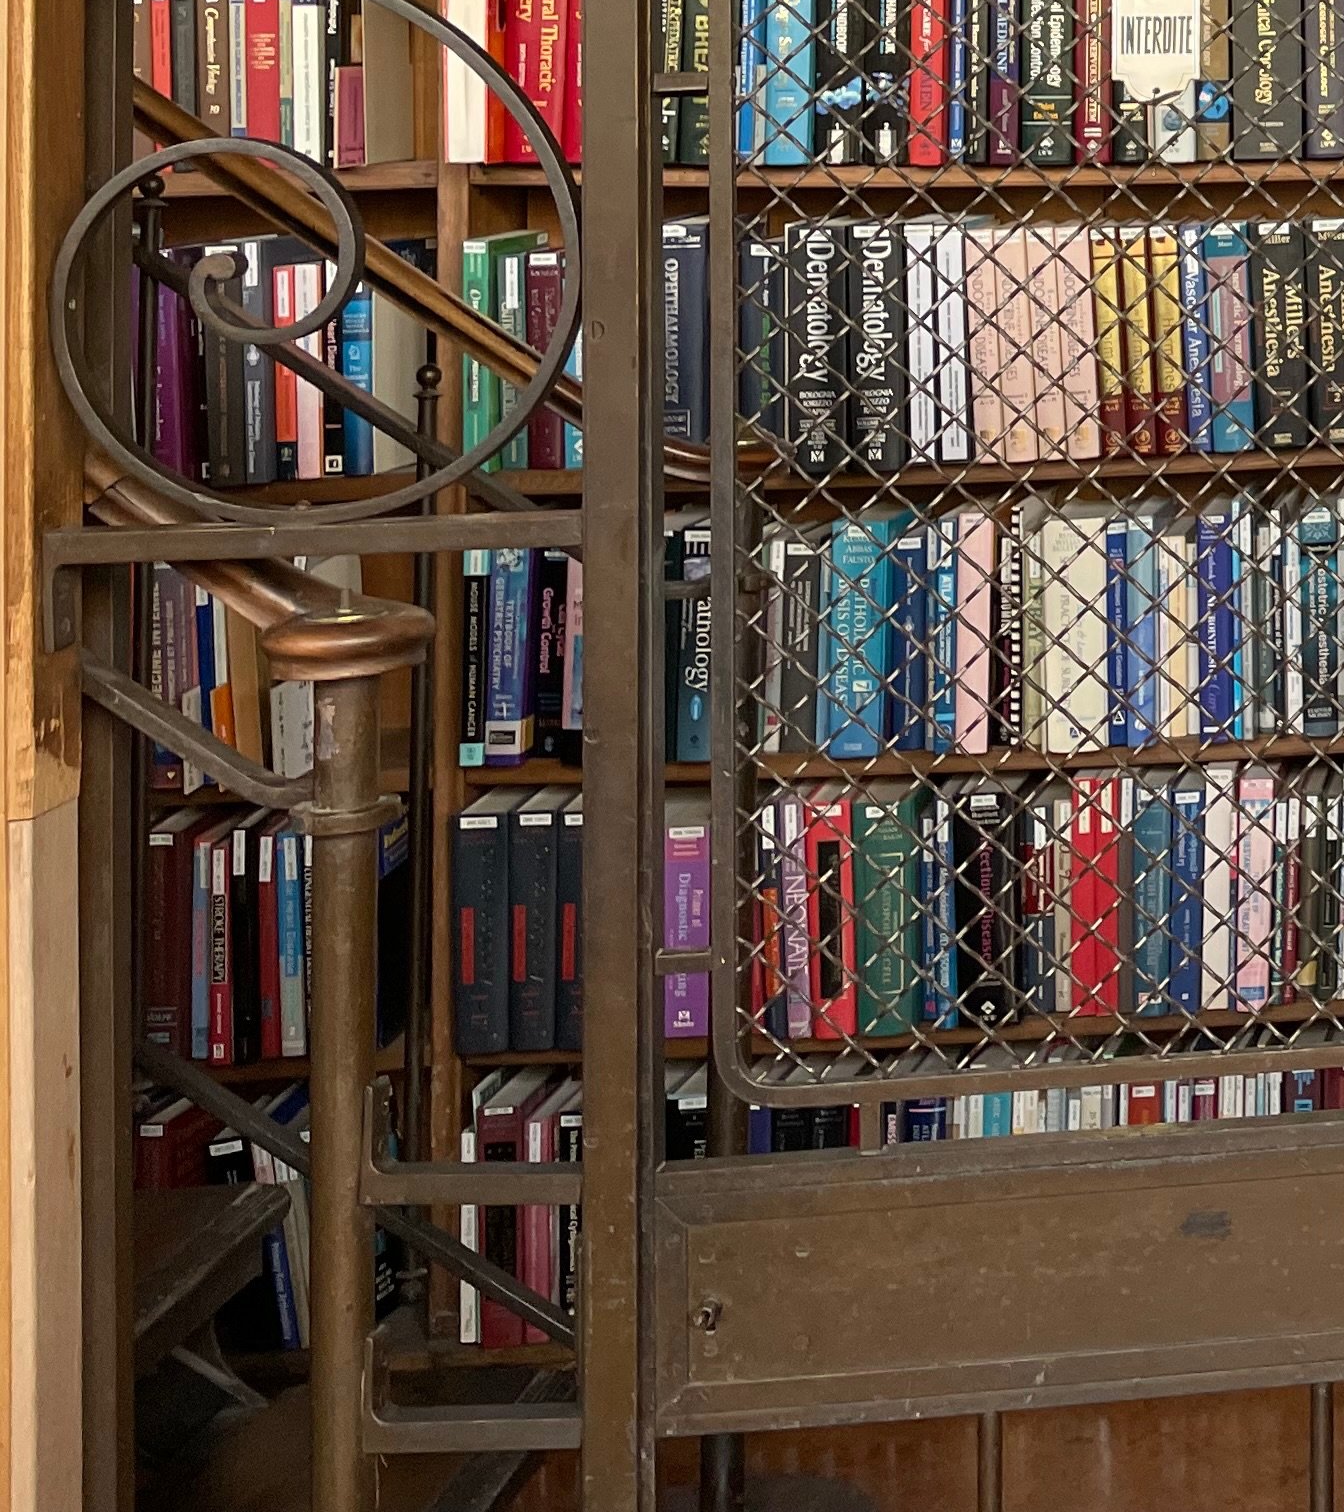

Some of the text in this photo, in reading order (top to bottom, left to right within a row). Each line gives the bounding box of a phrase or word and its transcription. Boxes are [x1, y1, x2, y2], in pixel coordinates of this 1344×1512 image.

[540, 23, 560, 92] Thoracic
[1120, 14, 1194, 56] INTERDITE
[664, 256, 680, 404] OPHTHALMOLOGY
[468, 615, 479, 652] MODELS
[503, 599, 515, 670] TEXTBOOK OF
[539, 631, 553, 675] Control
[467, 664, 477, 699] HUMAN
[466, 700, 476, 738] CANCER
[676, 873, 692, 942] Diagnostic
[213, 896, 226, 982] STROKE THERAPY
